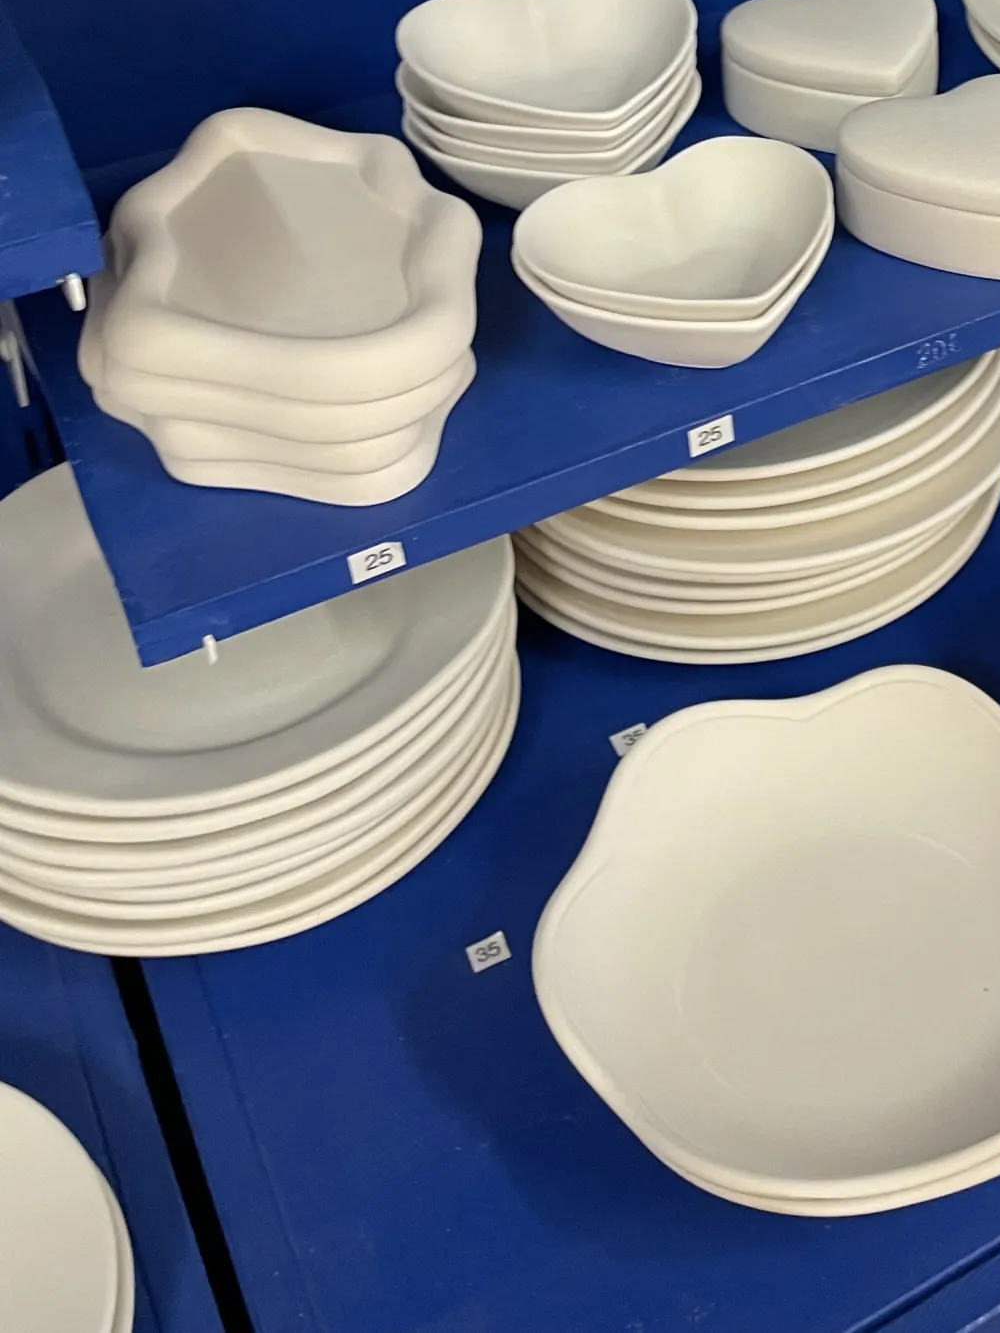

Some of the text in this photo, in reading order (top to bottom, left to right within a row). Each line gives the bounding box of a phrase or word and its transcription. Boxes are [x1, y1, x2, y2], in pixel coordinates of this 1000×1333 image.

[697, 425, 724, 446] 25
[364, 548, 393, 571] 25
[475, 942, 501, 963] 35
